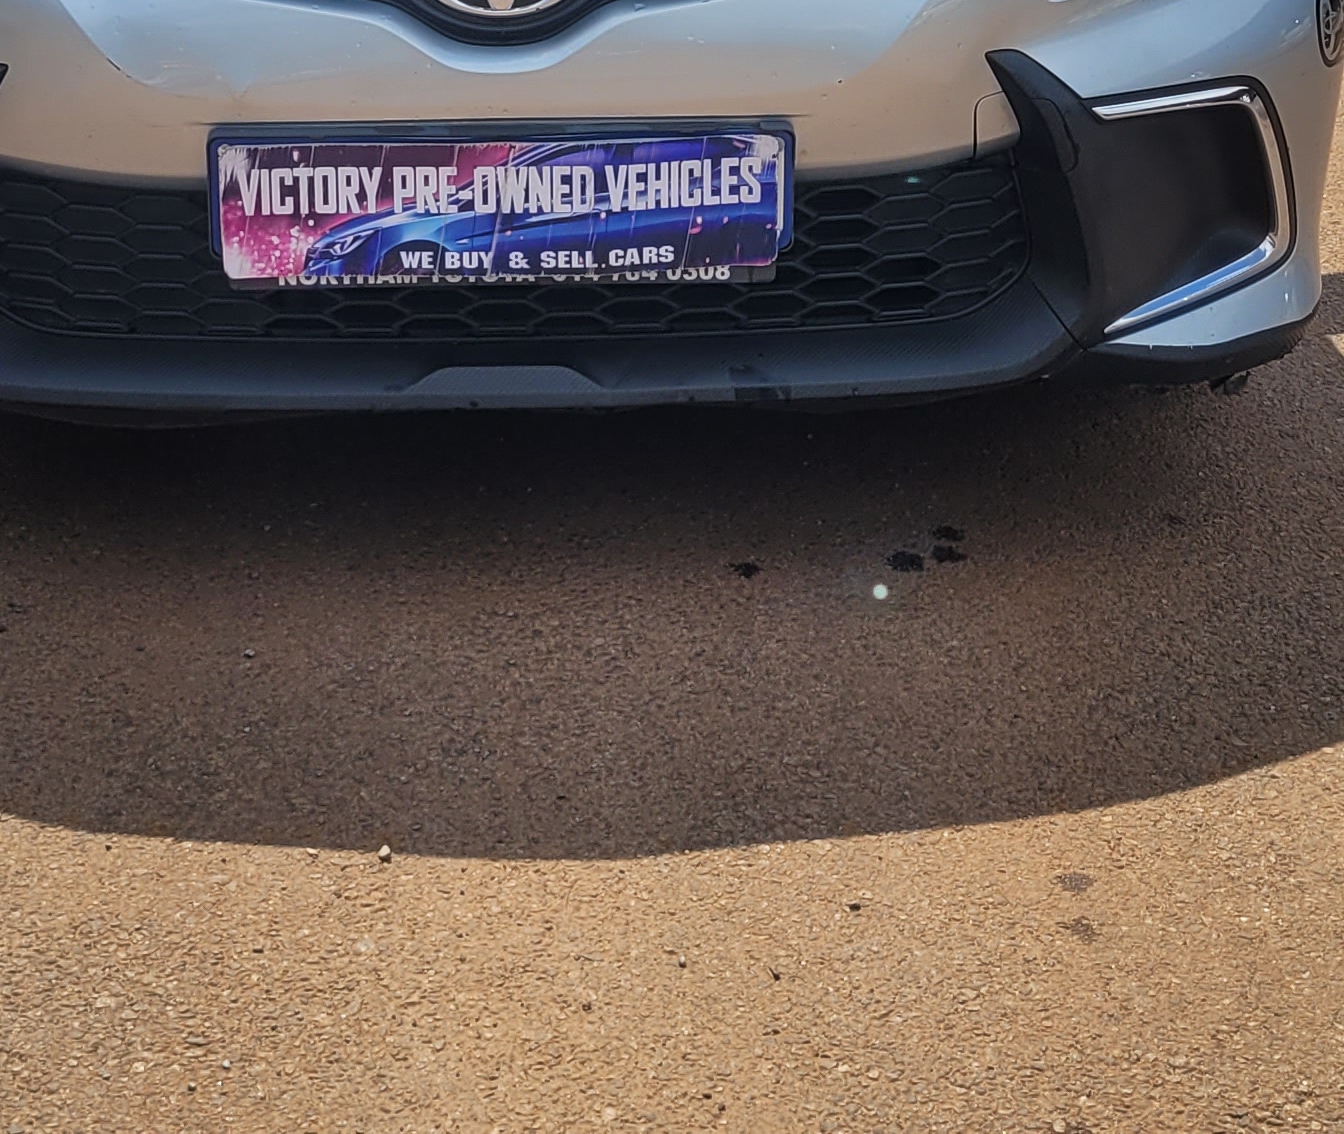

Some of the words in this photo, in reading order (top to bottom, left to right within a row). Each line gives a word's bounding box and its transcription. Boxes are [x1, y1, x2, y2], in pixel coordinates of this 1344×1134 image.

[237, 166, 384, 216] VICTORY
[392, 165, 595, 214] PRE-OWNED
[604, 156, 762, 213] VEHICLES
[399, 250, 435, 270] WE
[444, 250, 494, 270] BUY
[508, 251, 531, 269] &
[608, 245, 676, 266] CARS
